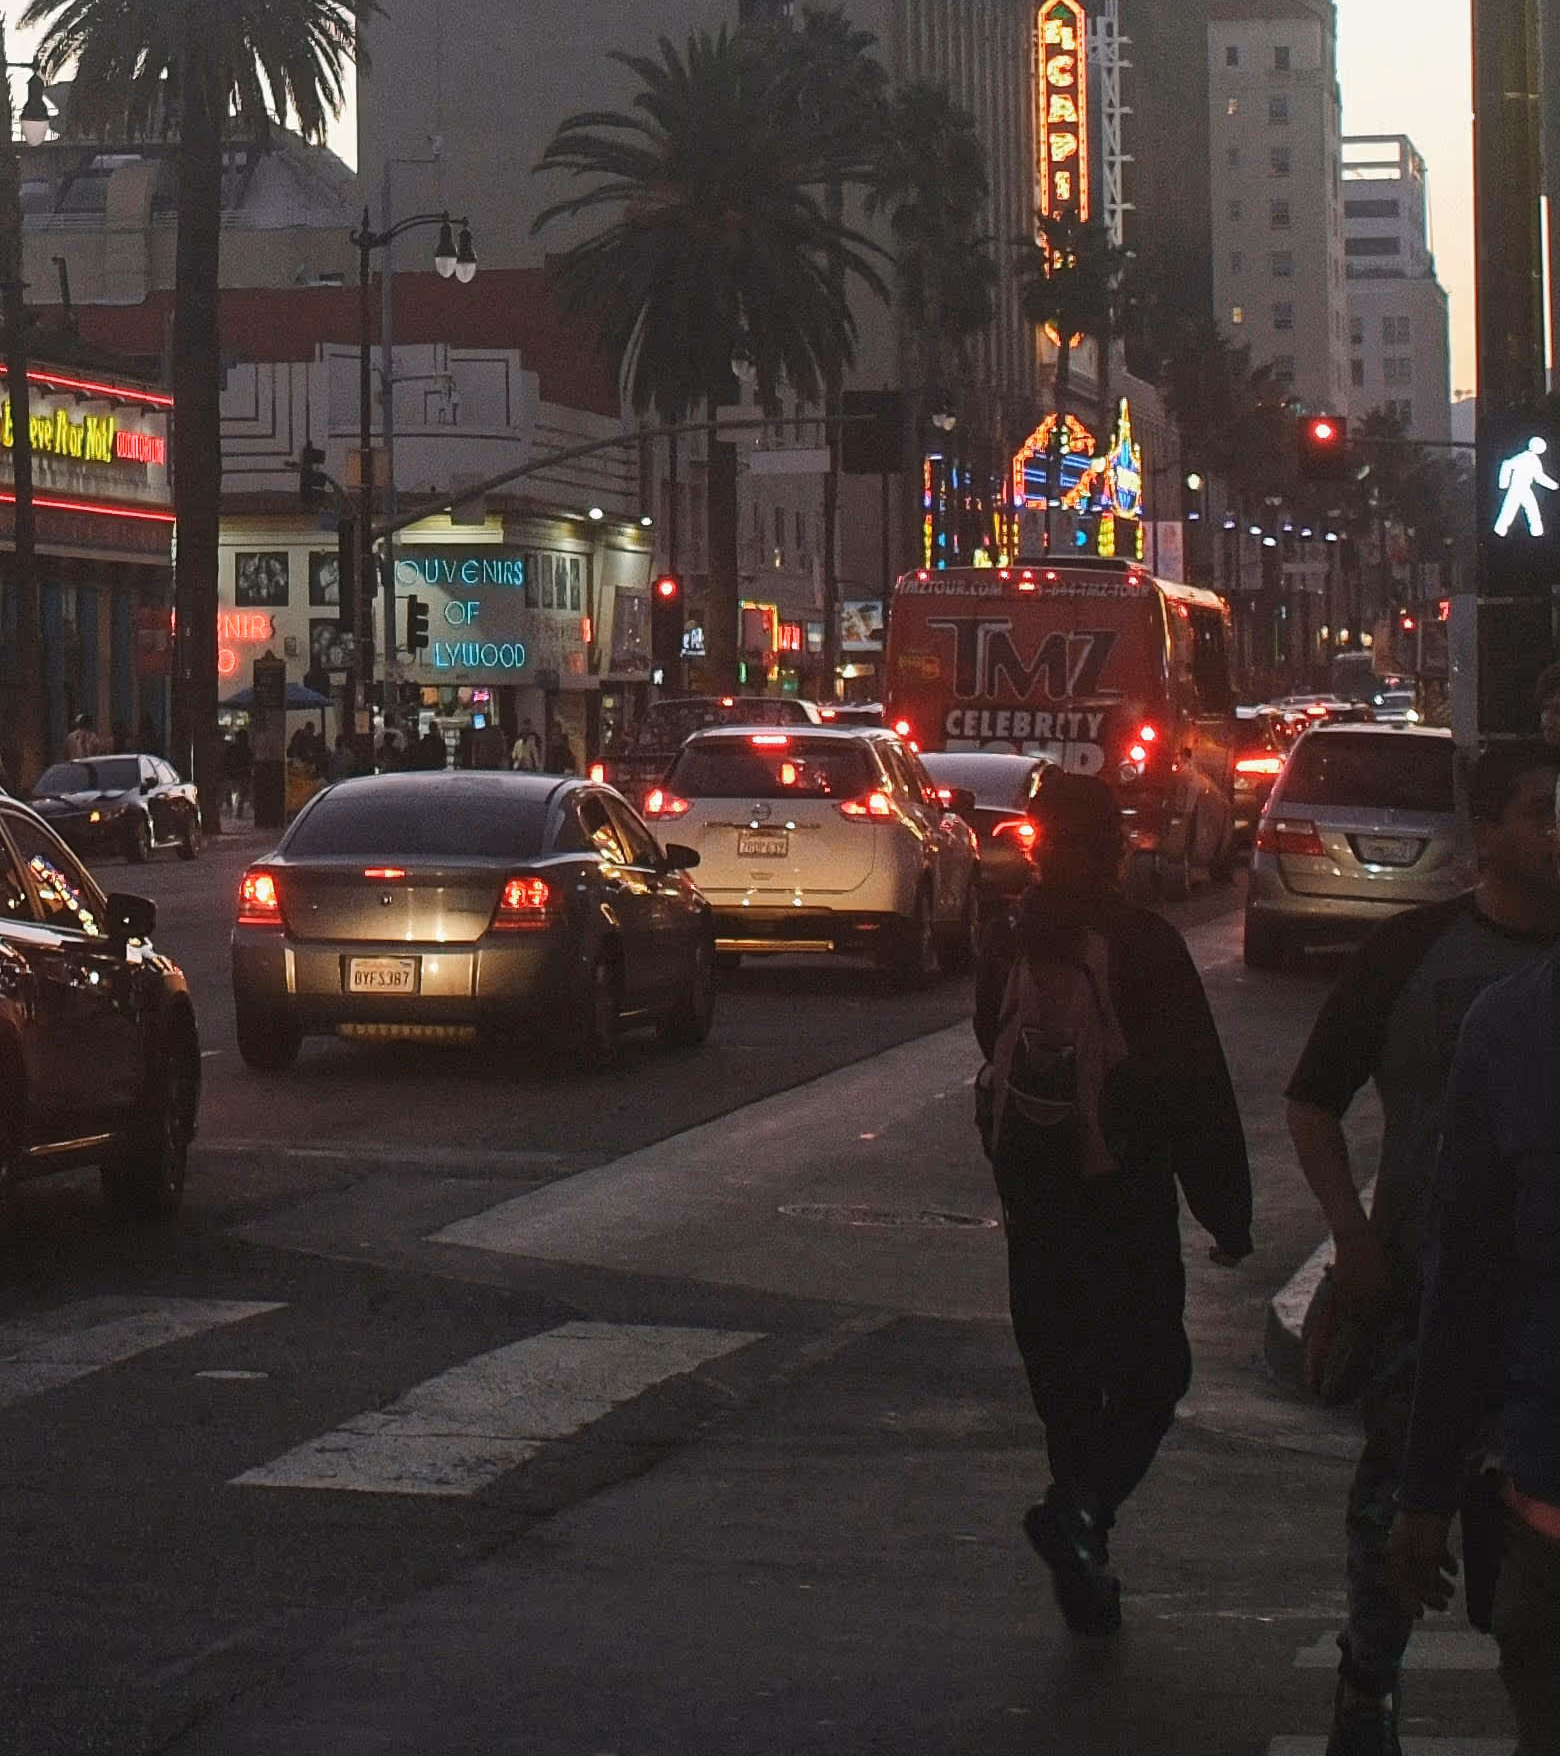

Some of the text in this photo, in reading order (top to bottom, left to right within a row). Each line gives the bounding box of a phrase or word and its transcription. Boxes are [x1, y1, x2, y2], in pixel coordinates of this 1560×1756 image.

[1047, 54, 1079, 201] CAPI
[396, 559, 525, 586] OUVENIRS
[444, 600, 481, 626] OF
[926, 615, 1122, 707] TMZ
[945, 707, 1107, 741] CELEBRITY
